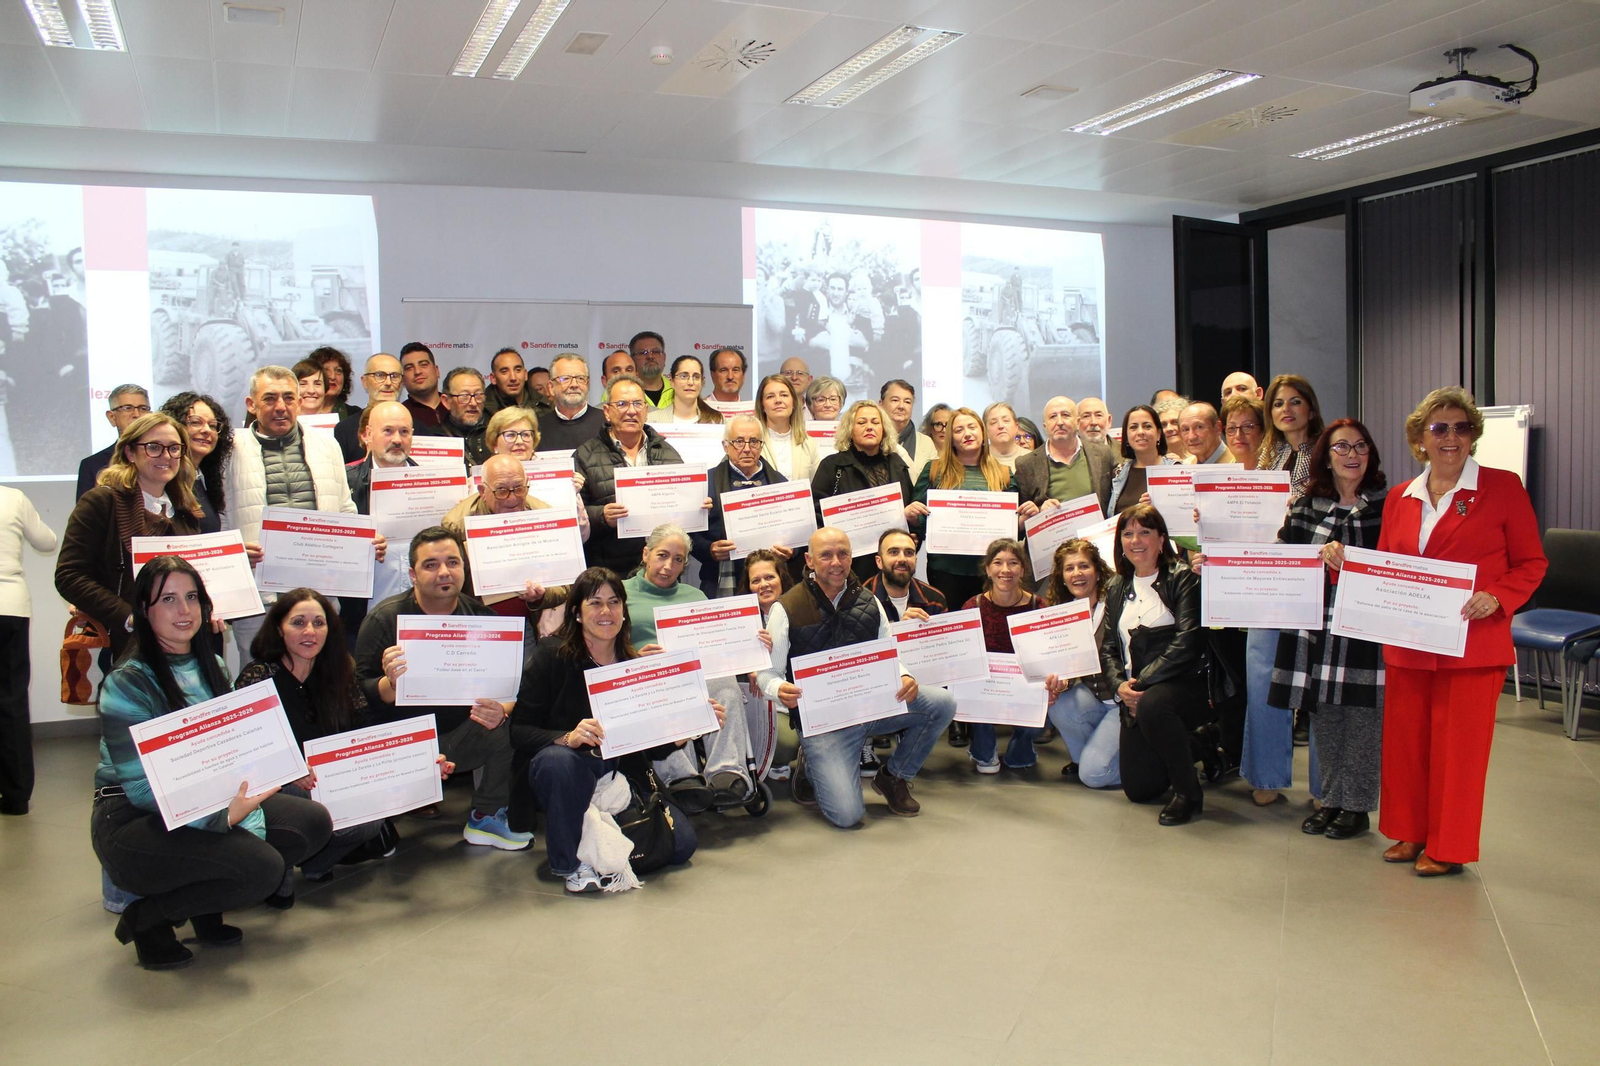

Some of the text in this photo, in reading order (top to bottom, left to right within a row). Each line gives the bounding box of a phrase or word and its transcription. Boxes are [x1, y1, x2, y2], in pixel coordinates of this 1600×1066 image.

[1367, 567, 1394, 575] Programa
[1417, 575, 1447, 584] 2025-2026
[1375, 586, 1406, 596] Asociación
[856, 654, 879, 663] 2025-2026
[612, 678, 637, 686] Programa
[656, 667, 680, 676] 2025-2026
[188, 705, 228, 722] Sandfire matsa
[167, 706, 254, 741] Programa Alianza 2025-2026
[169, 726, 262, 762] Sociedad Deportiva Cazadores Calañas
[190, 738, 205, 746] Ayuda
[206, 729, 230, 741] concedida
[335, 748, 362, 757] Programa
[385, 736, 413, 746] 2025-2026
